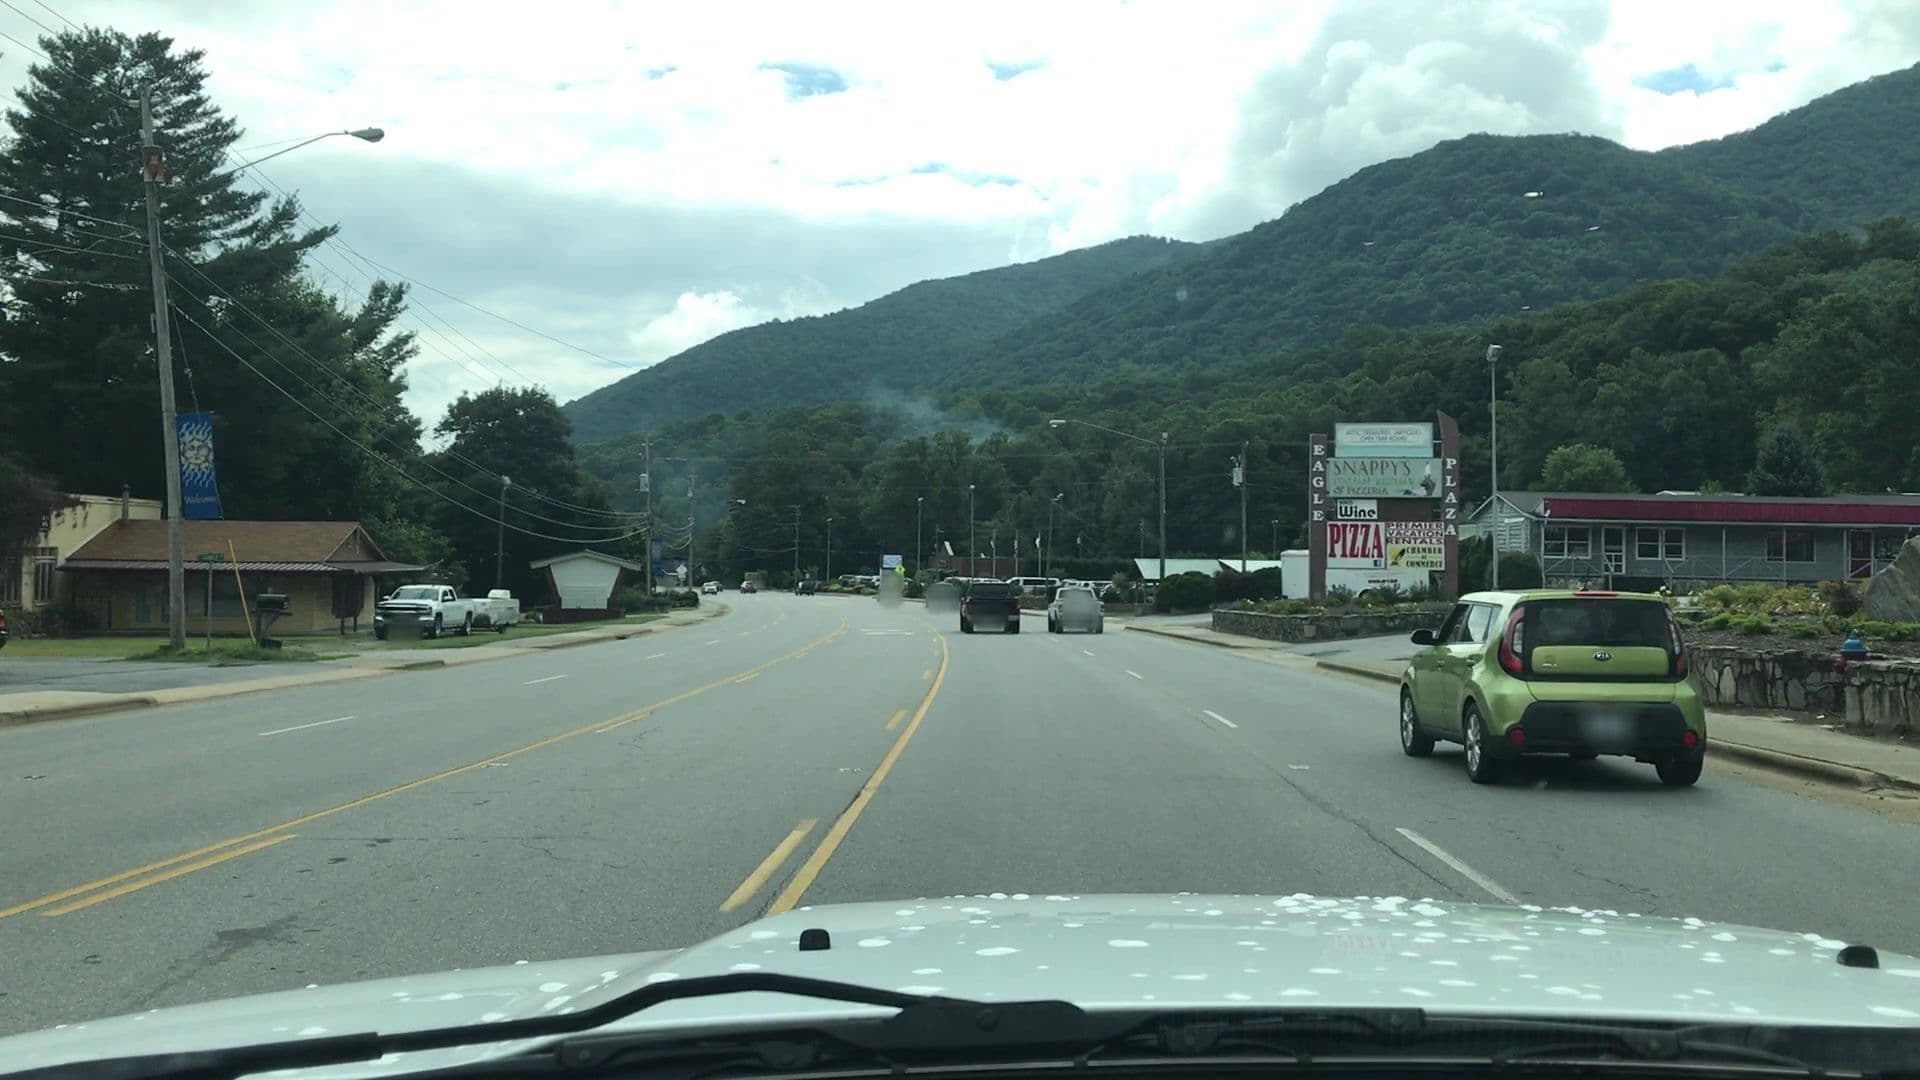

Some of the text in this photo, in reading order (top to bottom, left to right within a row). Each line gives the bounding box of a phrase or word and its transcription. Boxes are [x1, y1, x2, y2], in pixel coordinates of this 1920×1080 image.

[1334, 460, 1411, 476] SNAPPY'S
[1312, 444, 1325, 521] EAGLE
[1347, 487, 1389, 495] PIZZERIA
[1444, 458, 1458, 535] PLAZA
[1339, 505, 1376, 518] Wine
[1328, 523, 1384, 558] PIZZA
[1386, 537, 1443, 545] RENTALS
[1406, 546, 1442, 554] CHAMBER
[1406, 560, 1442, 568] COMMERCE
[1596, 652, 1610, 660] KIA
